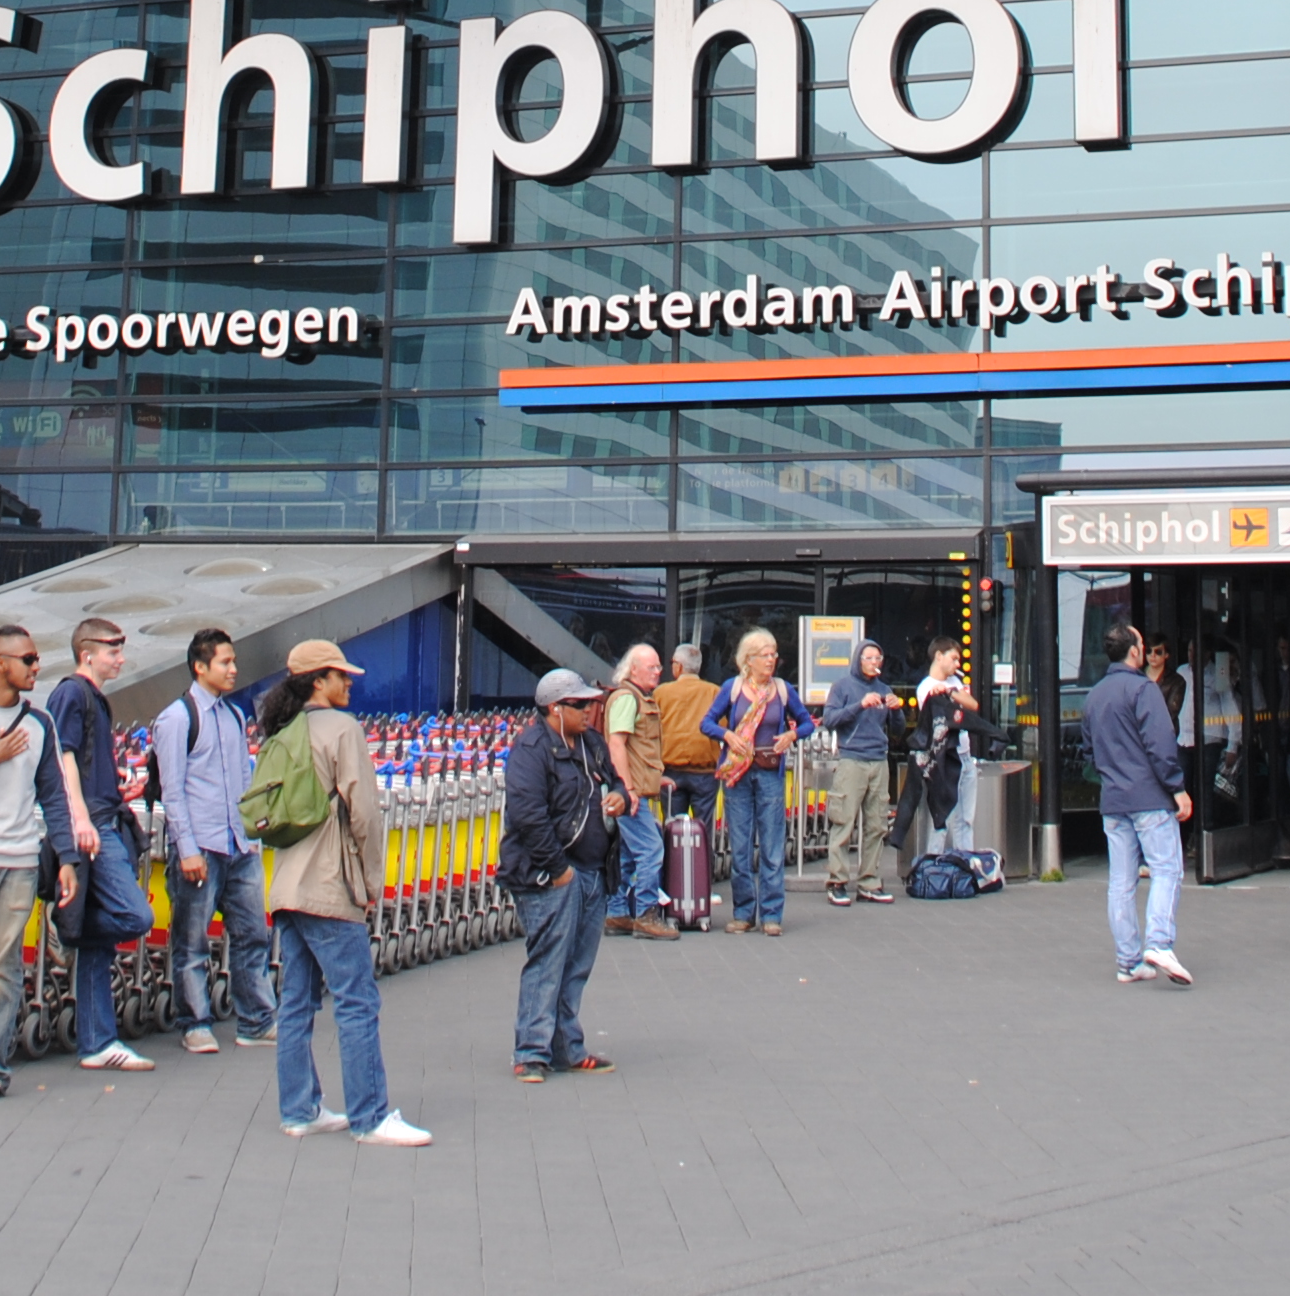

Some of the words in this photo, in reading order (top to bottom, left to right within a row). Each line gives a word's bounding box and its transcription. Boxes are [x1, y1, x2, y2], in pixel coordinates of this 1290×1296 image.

[505, 275, 854, 338] Amsterdam
[879, 263, 1117, 332] Airport
[24, 303, 360, 362] Spoorwegen
[437, 469, 447, 483] 3
[1057, 510, 1220, 552] Schiphol
